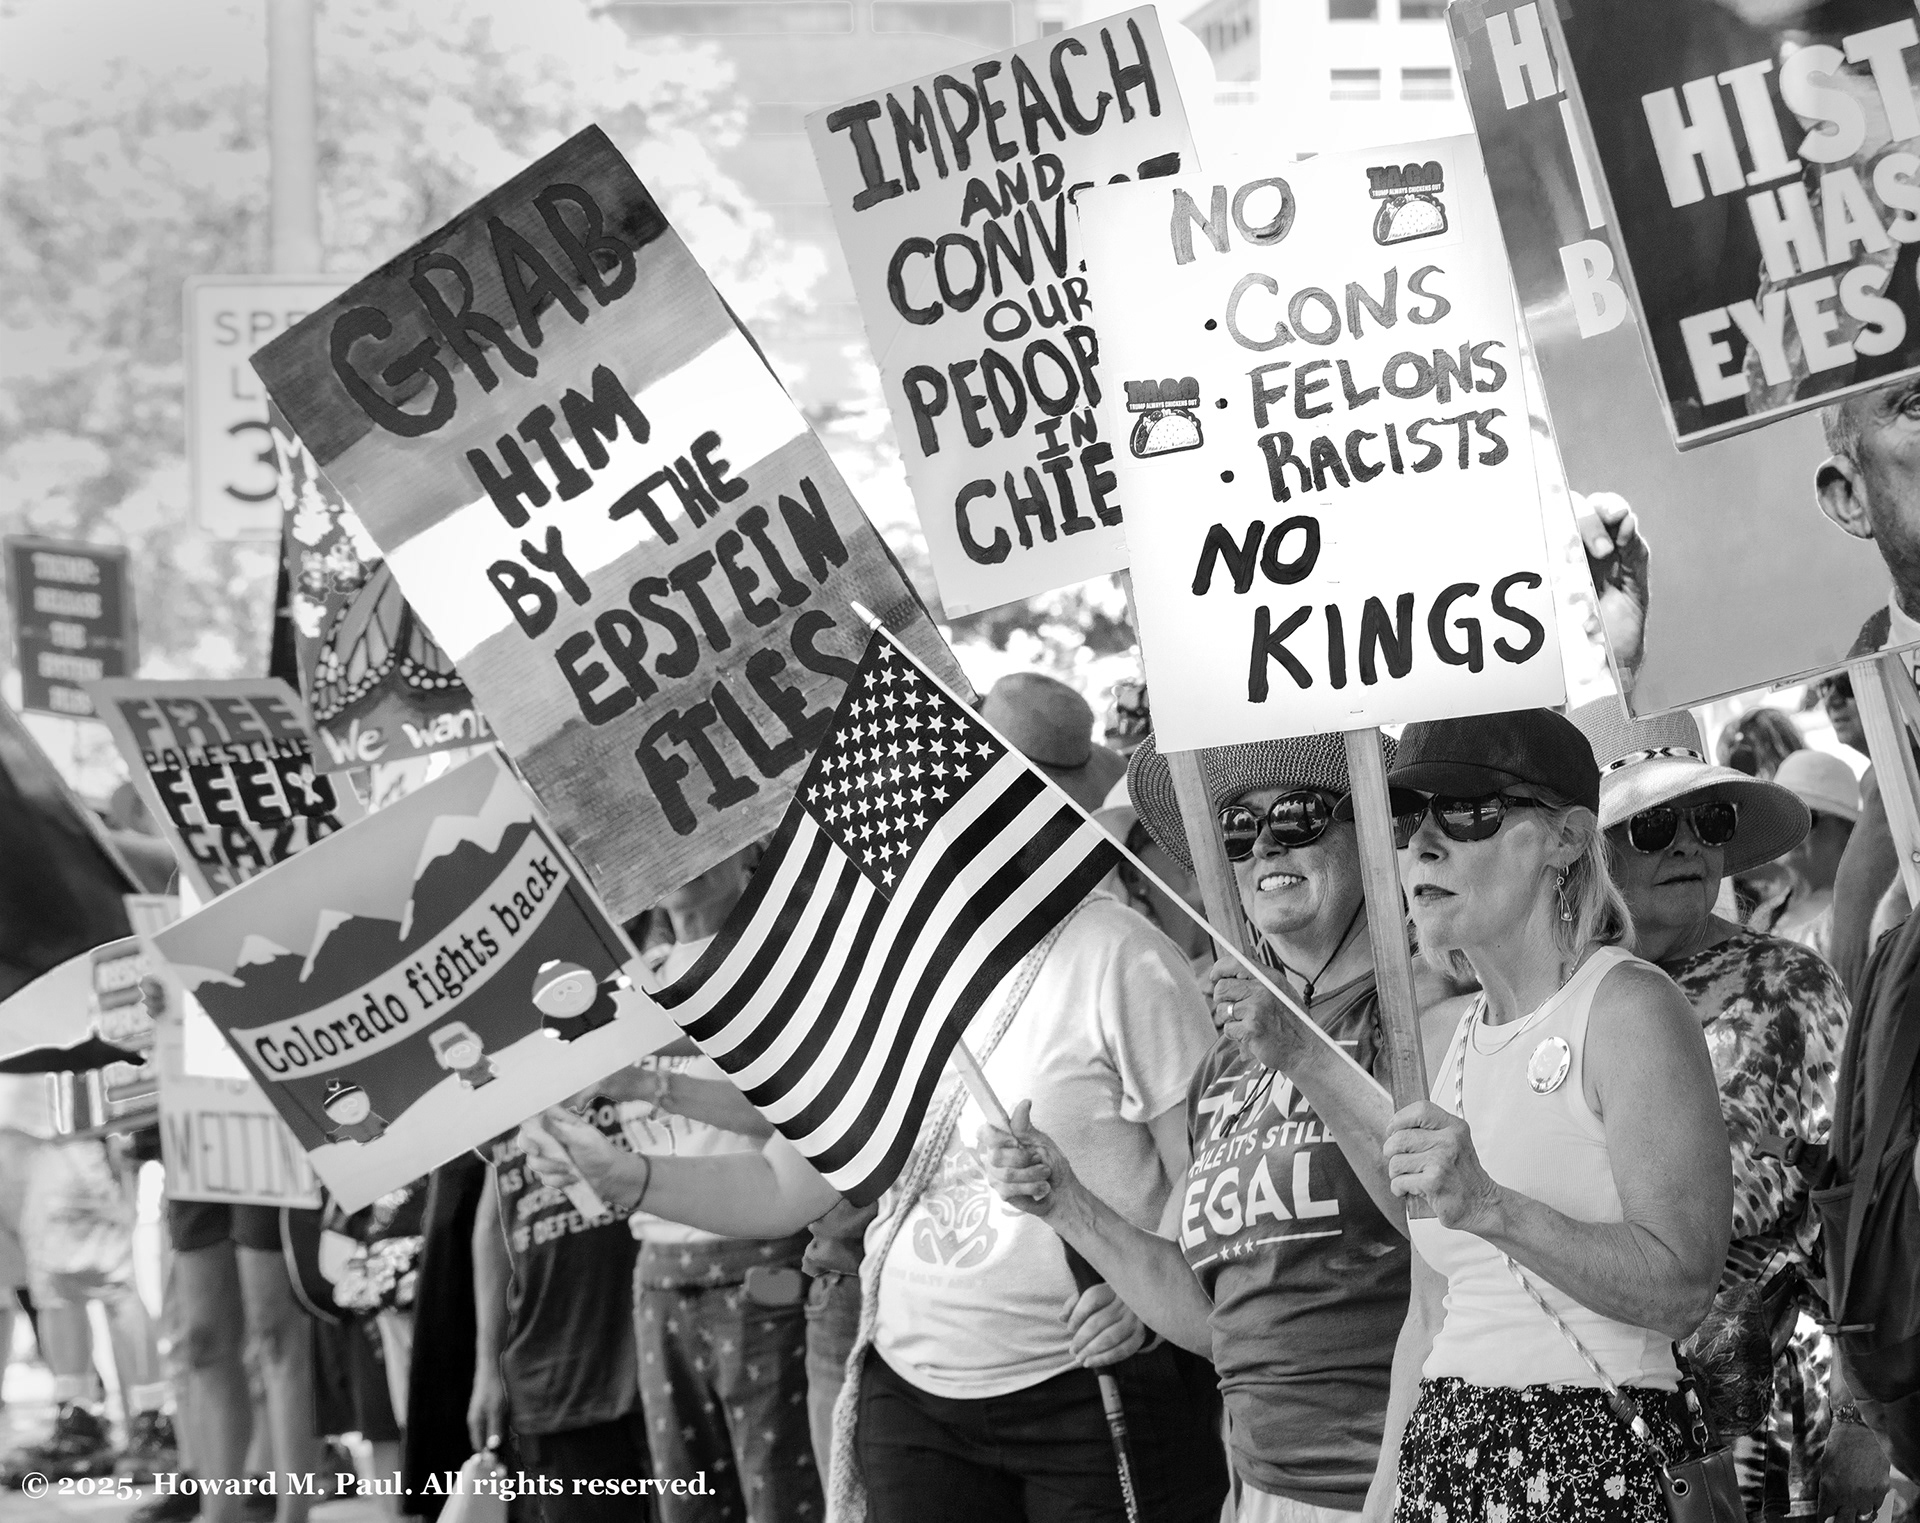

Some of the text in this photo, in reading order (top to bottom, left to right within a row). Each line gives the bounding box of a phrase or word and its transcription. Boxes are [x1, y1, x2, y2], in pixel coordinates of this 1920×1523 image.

[827, 17, 1160, 212] IMPEACH
[1641, 17, 1919, 208] HIST
[887, 152, 1181, 326] CONV
[961, 153, 1064, 227] AND
[1170, 177, 1296, 265] NO
[1746, 152, 1920, 283] HAS
[331, 183, 636, 437] GRAB
[984, 277, 1093, 342] OUR
[1679, 265, 1907, 405] EYES
[467, 364, 650, 529] HIM
[1035, 406, 1098, 460] IN
[1246, 340, 1507, 428] FELONS
[1257, 408, 1509, 502] RACISTS
[487, 431, 749, 639] BY THE
[1192, 515, 1320, 596] NO
[555, 477, 849, 726] EPSTEIN
[1247, 571, 1545, 703] KINGS
[115, 698, 313, 752] FREE
[318, 718, 389, 765] We
[635, 610, 858, 836] FILES
[255, 856, 558, 1073] Colorado fights back
[1262, 1121, 1338, 1150] STILL
[1179, 1152, 1340, 1252] EGAL
